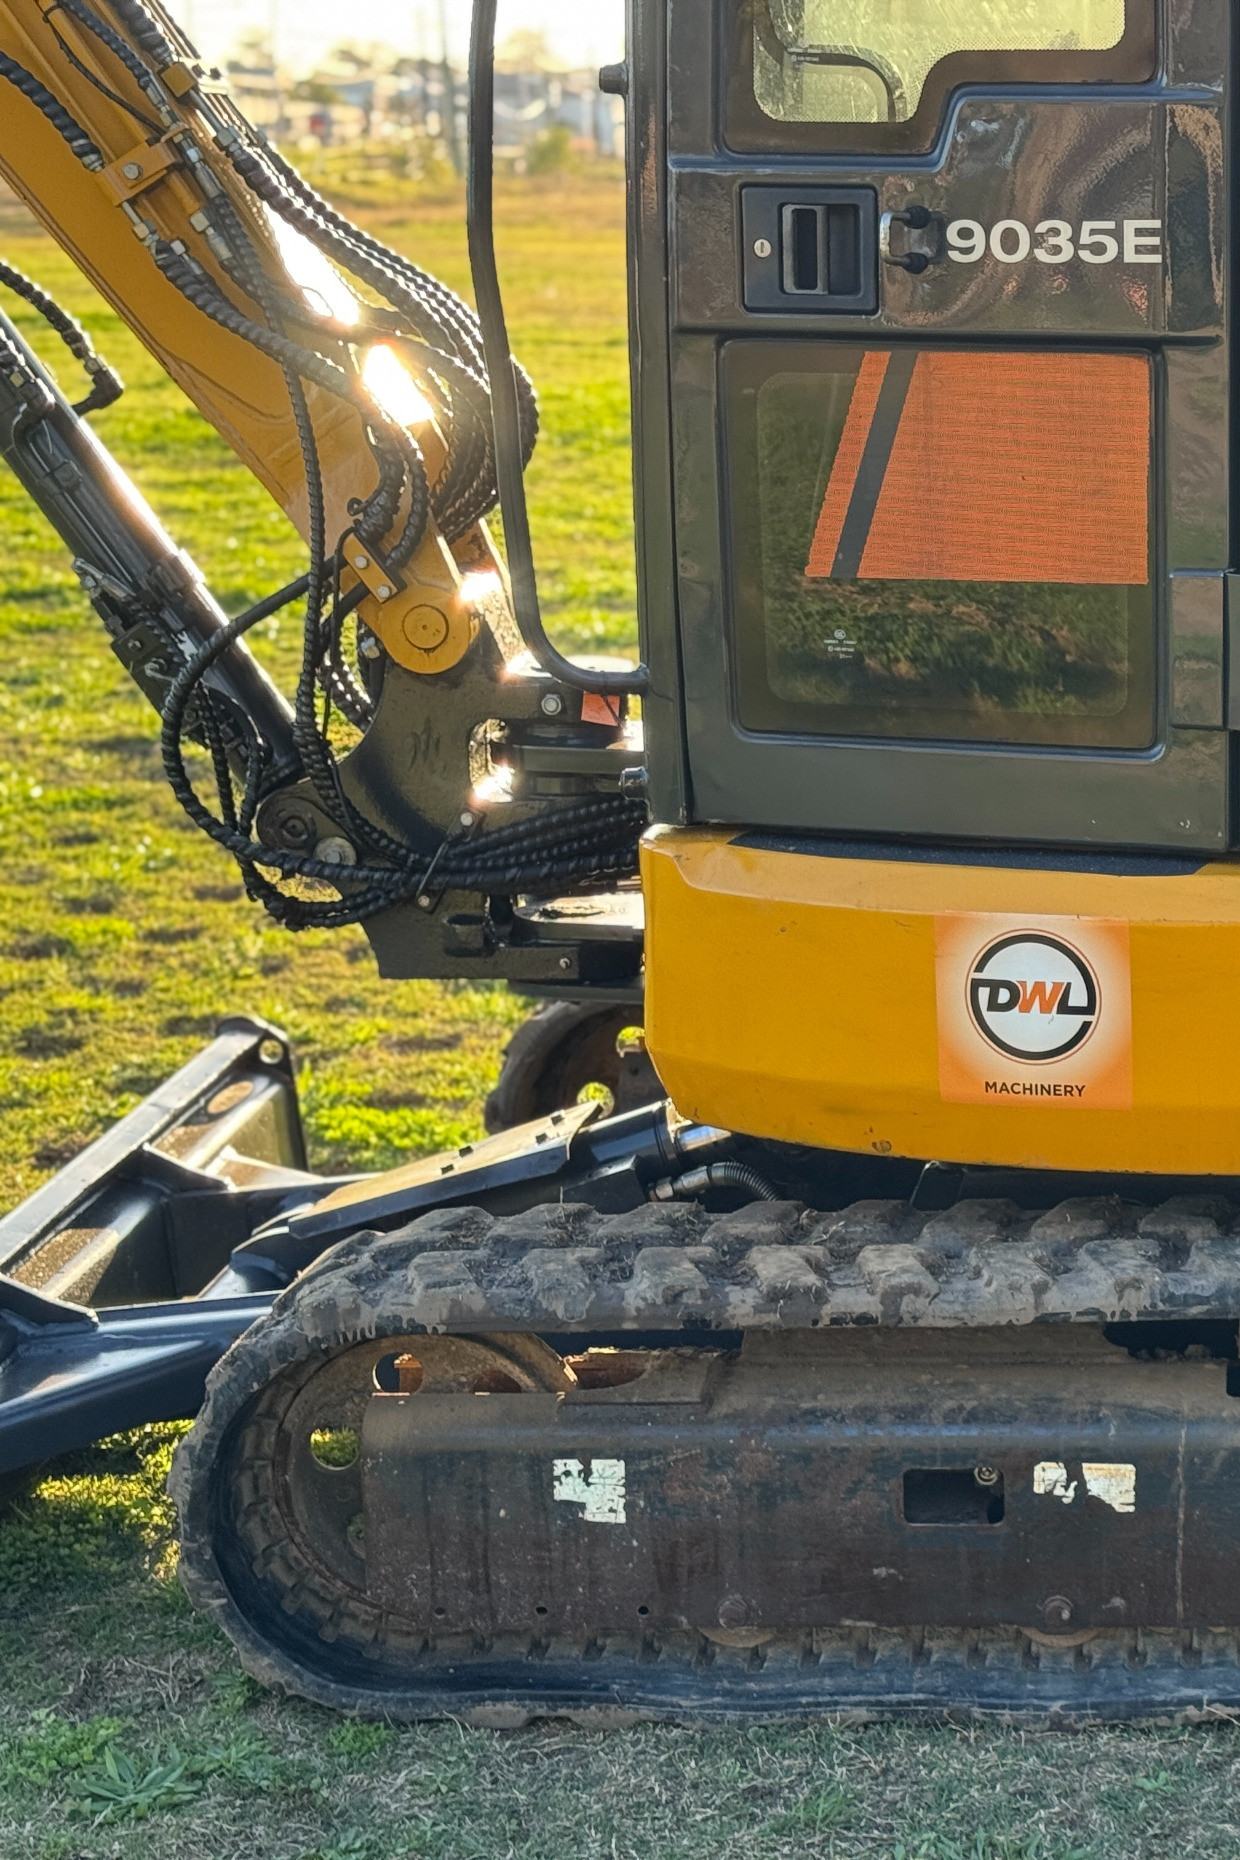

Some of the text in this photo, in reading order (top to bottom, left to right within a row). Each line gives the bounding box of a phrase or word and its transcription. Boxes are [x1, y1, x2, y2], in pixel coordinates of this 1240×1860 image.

[945, 219, 1163, 264] 9035E
[970, 978, 1096, 1016] DWL
[984, 1080, 1087, 1098] MACHINERY
